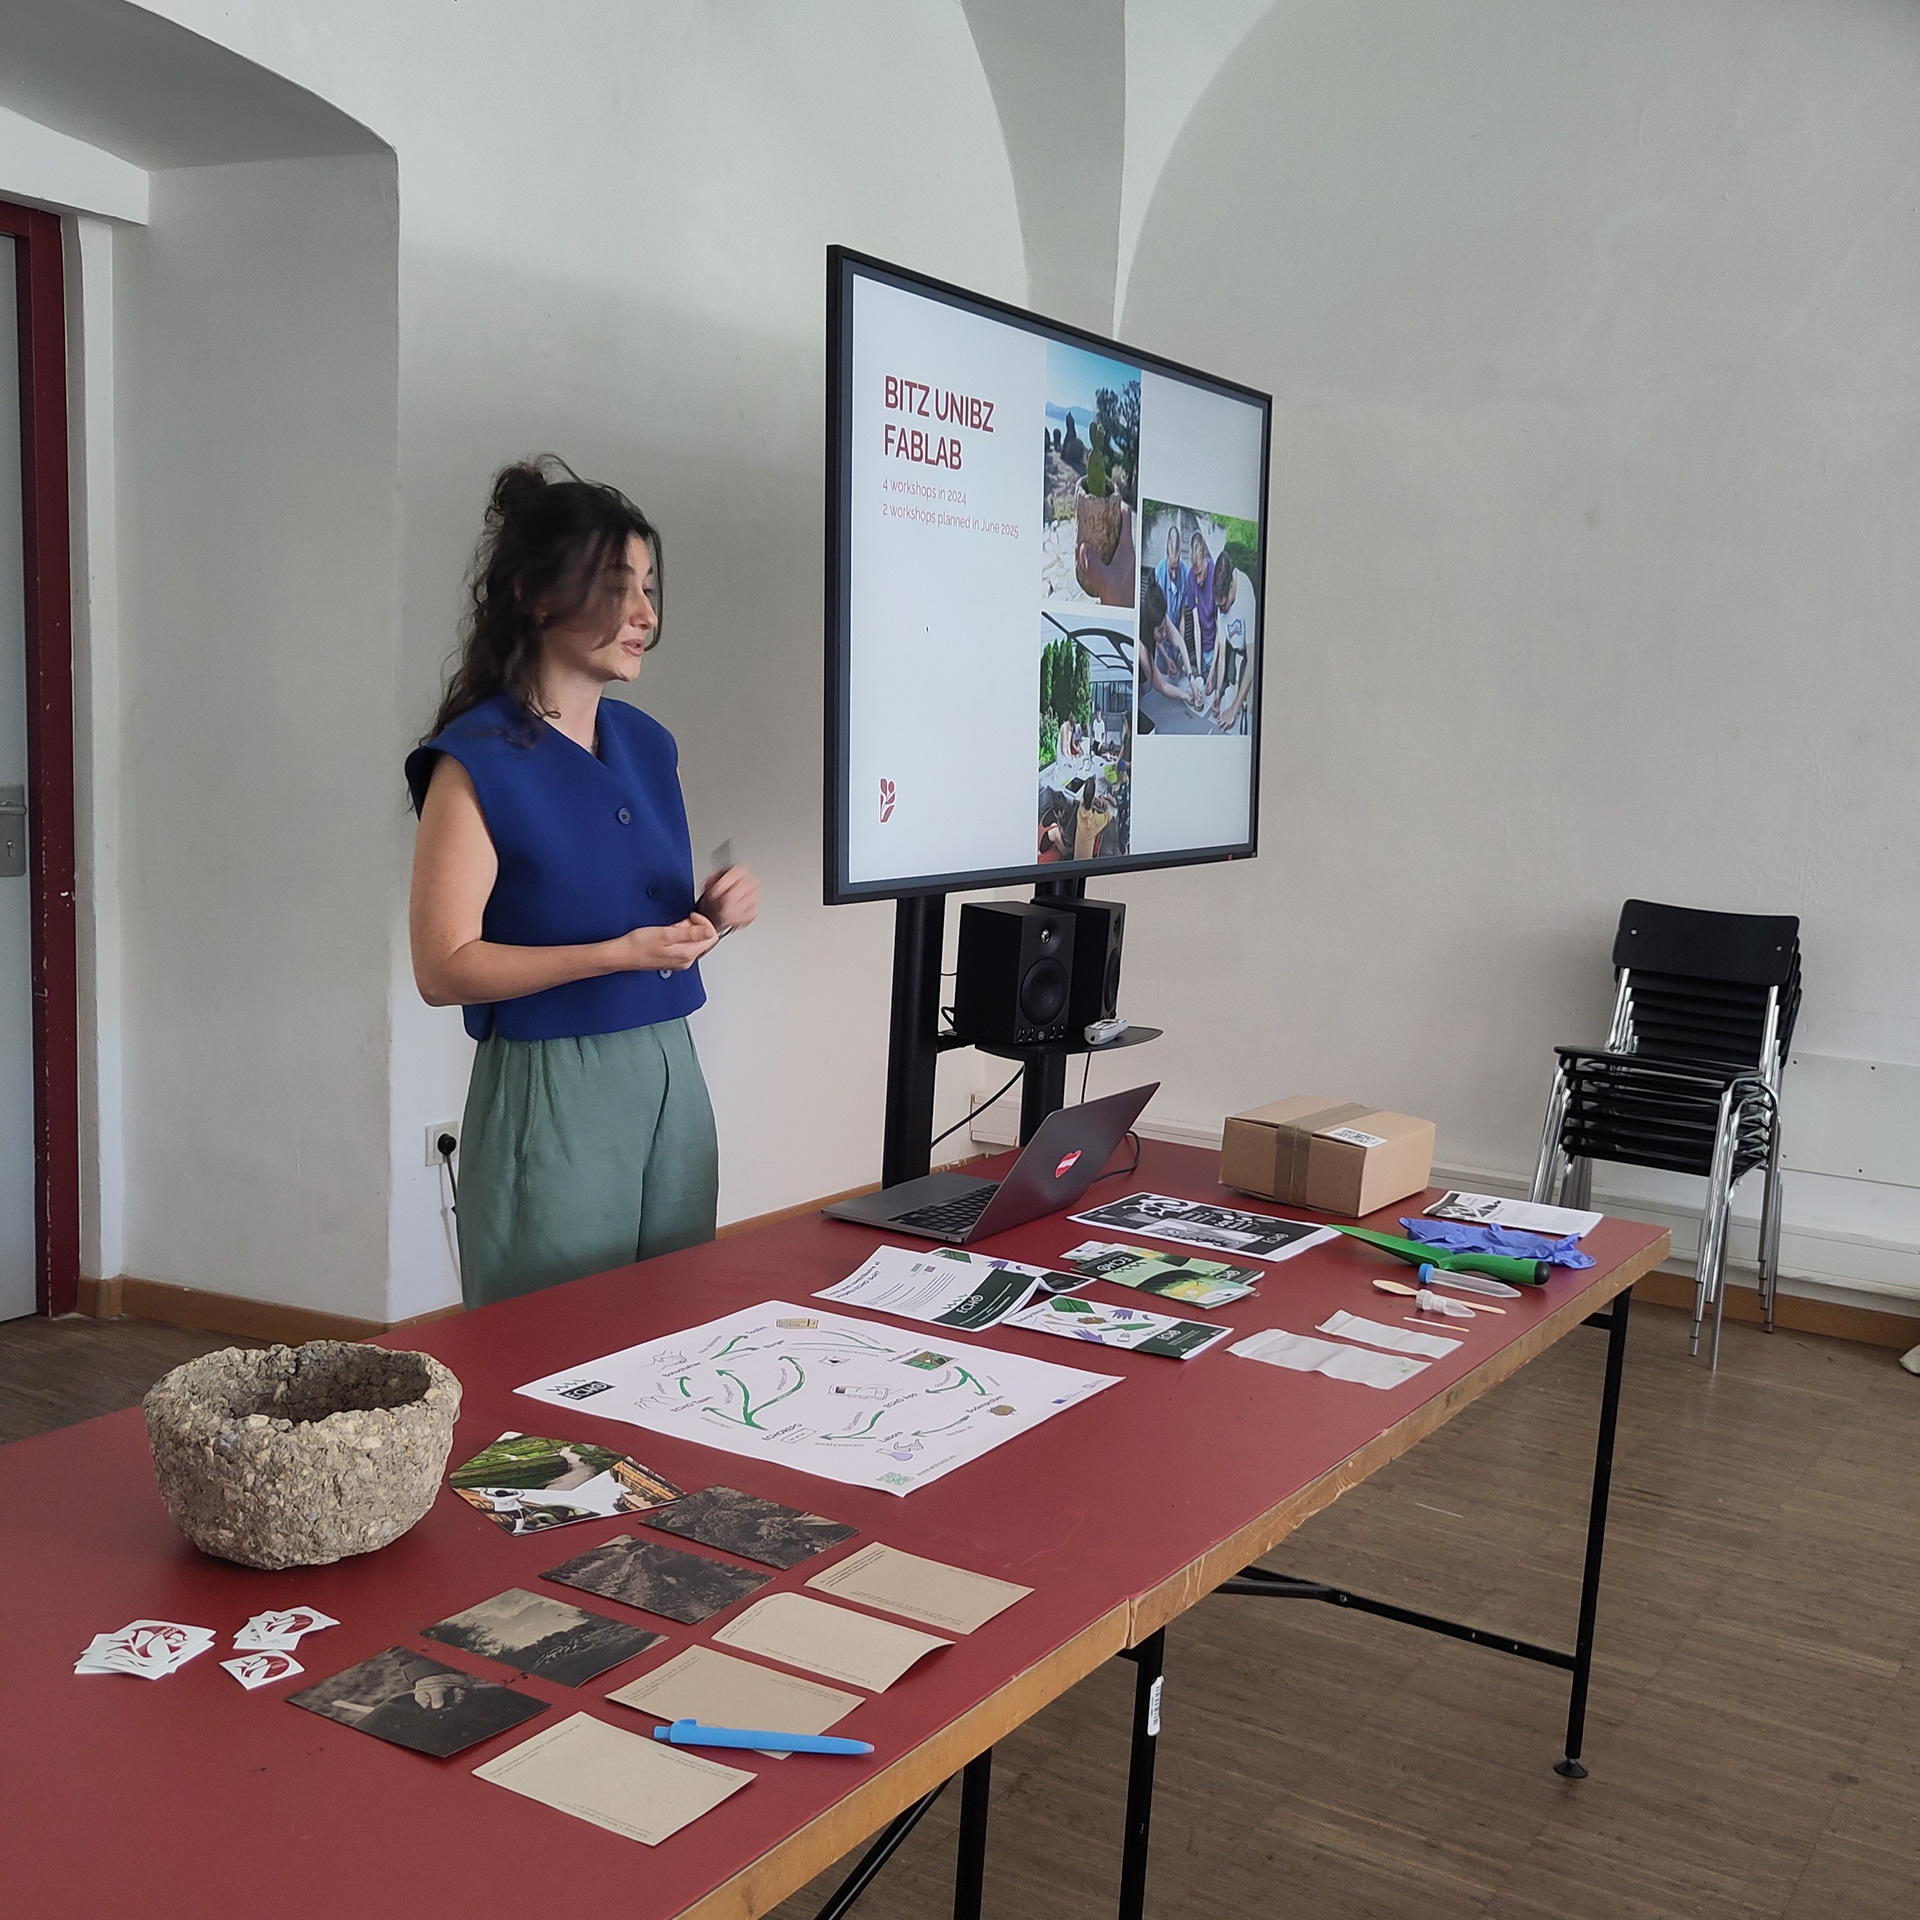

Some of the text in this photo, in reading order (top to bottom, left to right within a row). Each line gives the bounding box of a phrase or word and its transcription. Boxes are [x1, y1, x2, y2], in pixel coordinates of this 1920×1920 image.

[885, 375, 995, 433] BITZ UNIBZ
[884, 423, 962, 470] FABLAB
[883, 478, 967, 506] 4 workshops in 2024
[882, 503, 1019, 540] 2 workshops planned in June 2025
[955, 1294, 984, 1314] ECHO
[566, 1381, 609, 1400] ECHO
